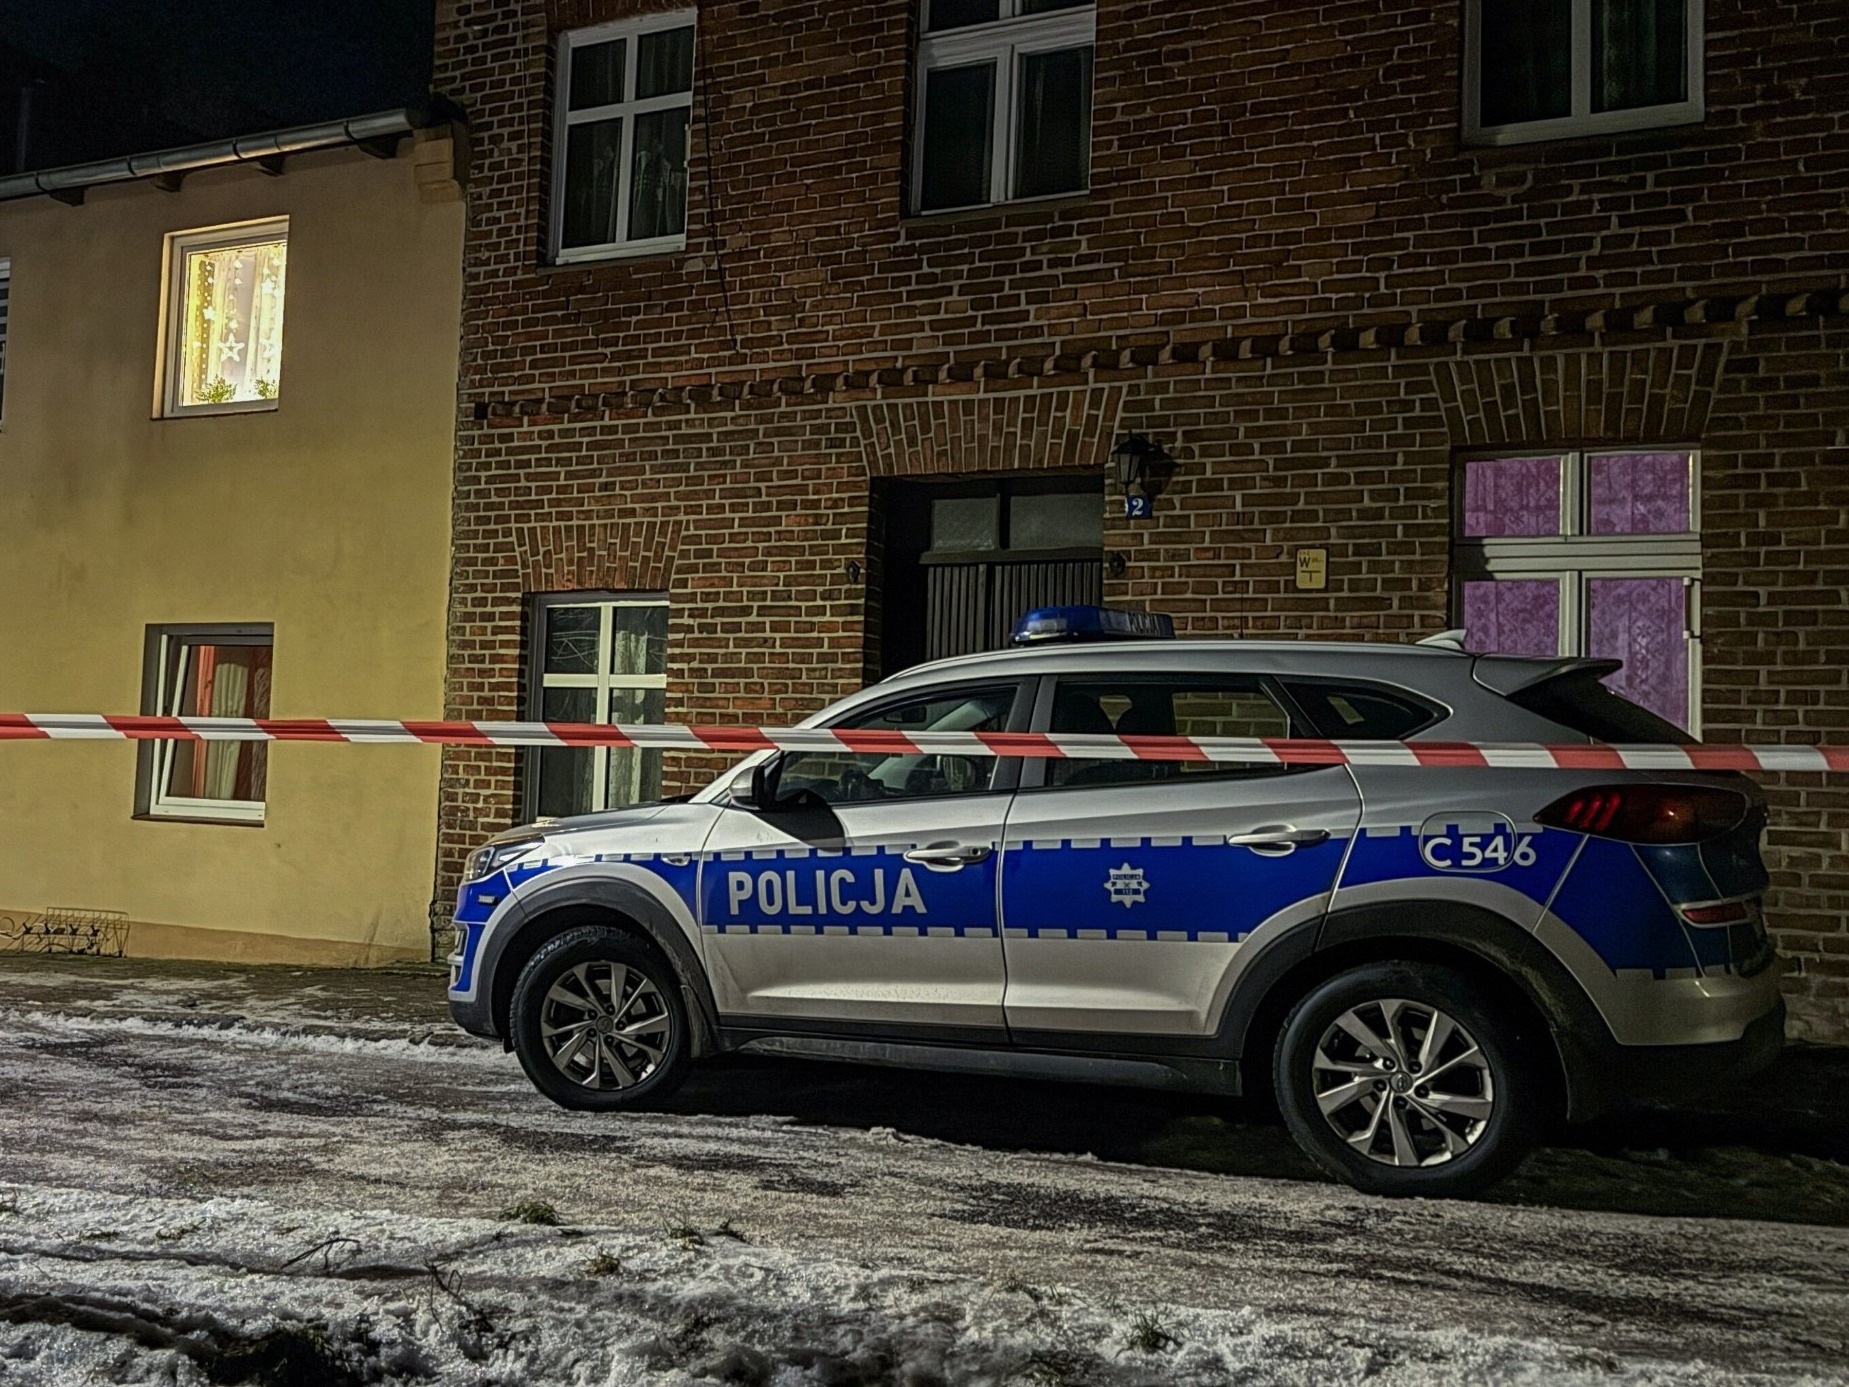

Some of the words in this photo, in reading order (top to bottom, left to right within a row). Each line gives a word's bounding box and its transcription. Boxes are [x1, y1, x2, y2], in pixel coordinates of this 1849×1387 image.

[1132, 497, 1144, 516] 2
[1299, 556, 1311, 568] W
[1424, 837, 1453, 868] C
[1461, 835, 1537, 867] 546
[728, 867, 928, 916] POLICJA
